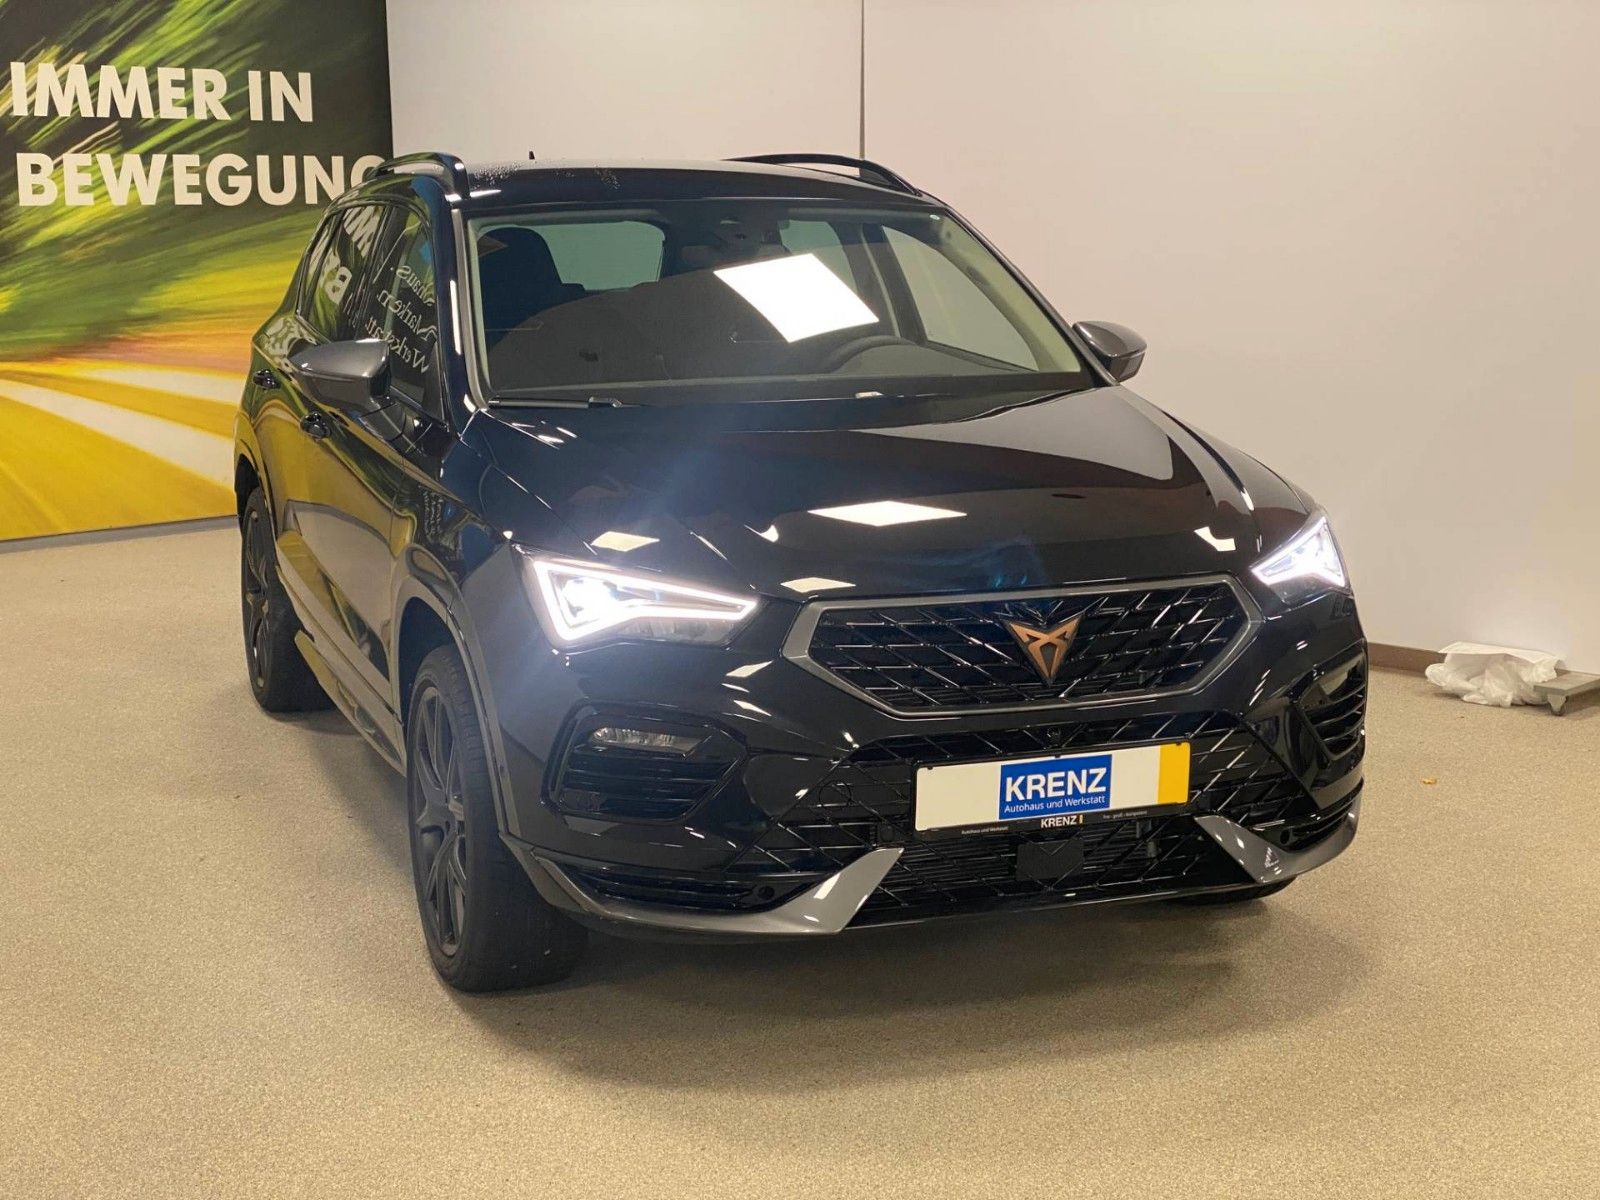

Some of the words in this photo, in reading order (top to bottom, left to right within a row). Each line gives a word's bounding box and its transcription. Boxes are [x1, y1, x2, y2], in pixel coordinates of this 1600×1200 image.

[10, 62, 231, 121] IMMER
[248, 70, 313, 122] IN
[1005, 767, 1107, 802] KRENZ
[1004, 802, 1045, 814] Autohaus
[1046, 799, 1063, 810] und
[1065, 795, 1106, 808] Werkstatt
[1040, 815, 1077, 829] KRENZ
